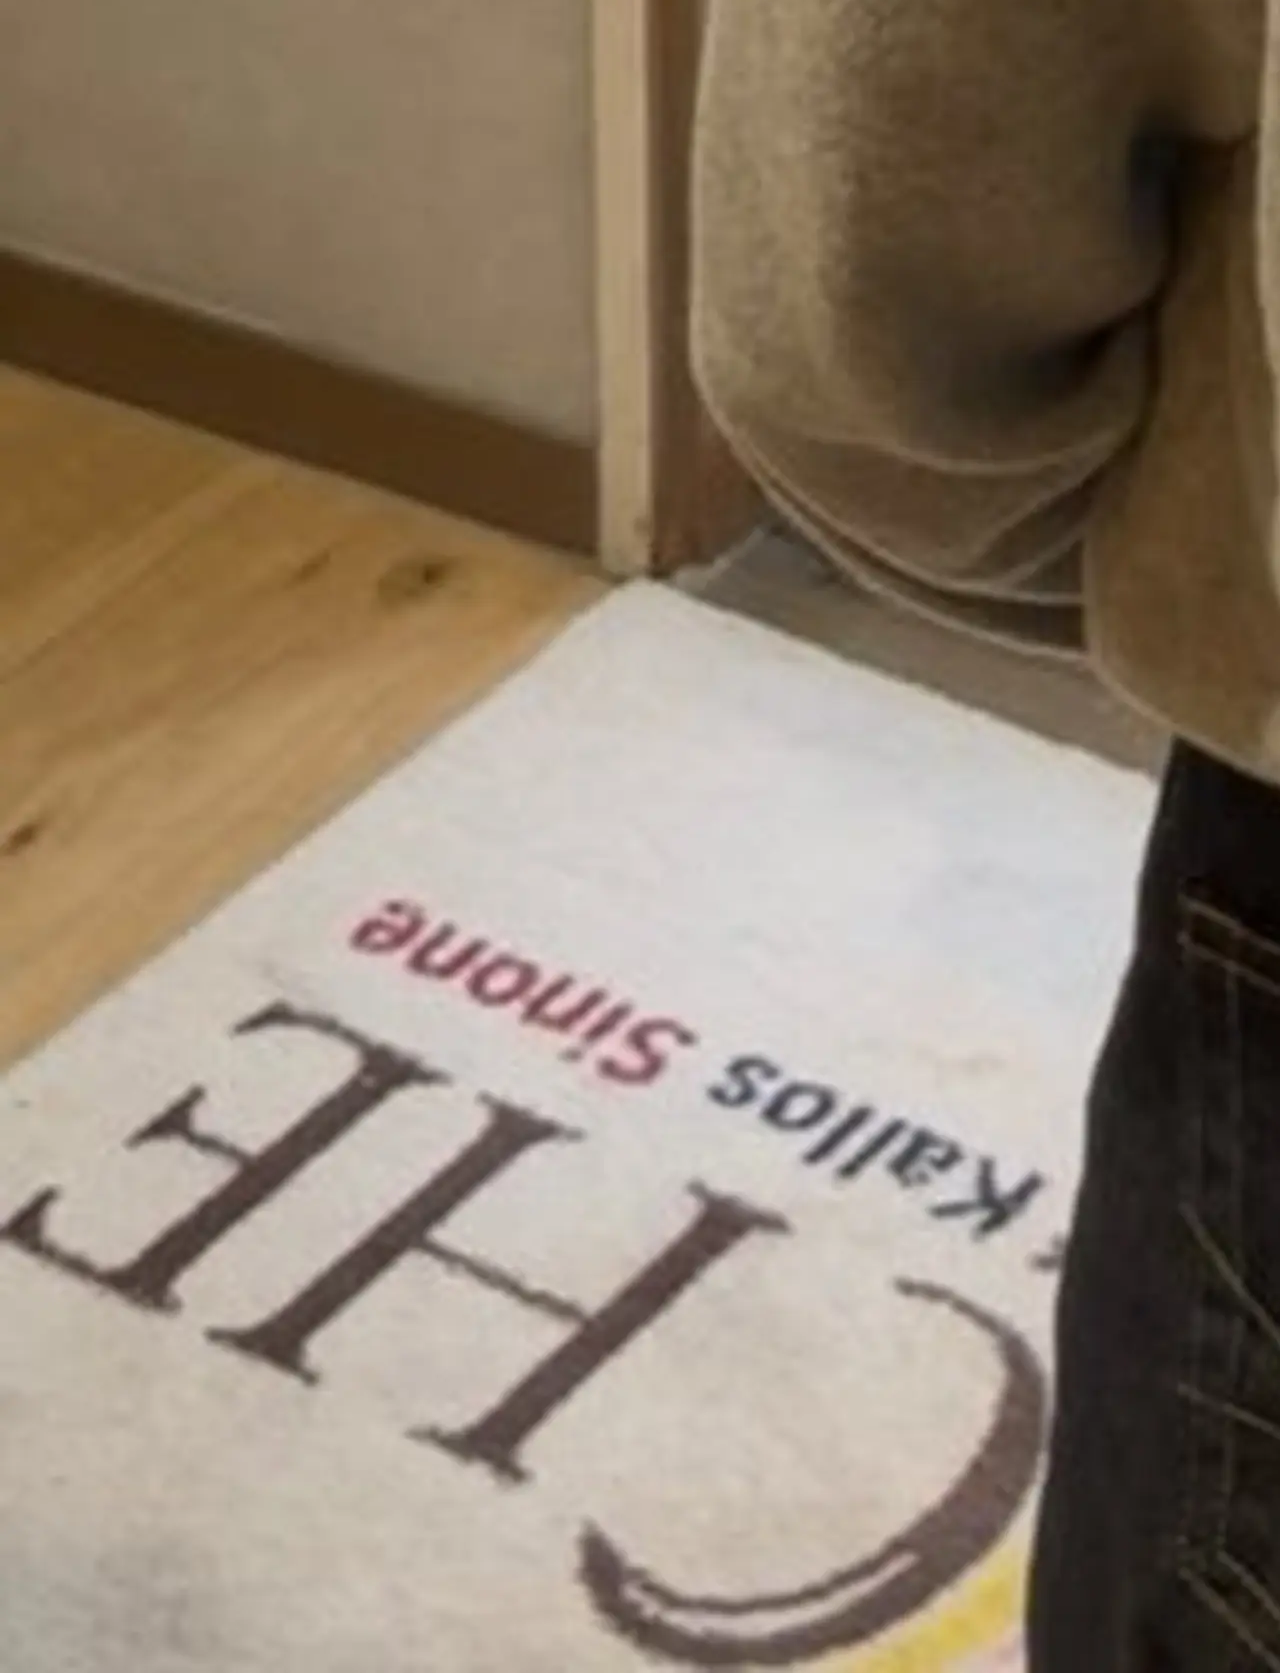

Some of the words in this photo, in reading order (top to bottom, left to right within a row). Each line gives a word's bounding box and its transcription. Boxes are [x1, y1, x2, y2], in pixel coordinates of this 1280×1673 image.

[351, 900, 697, 1087] Sinone
[708, 1055, 1042, 1239] Kallos
[1, 1002, 1047, 1666] CHE
